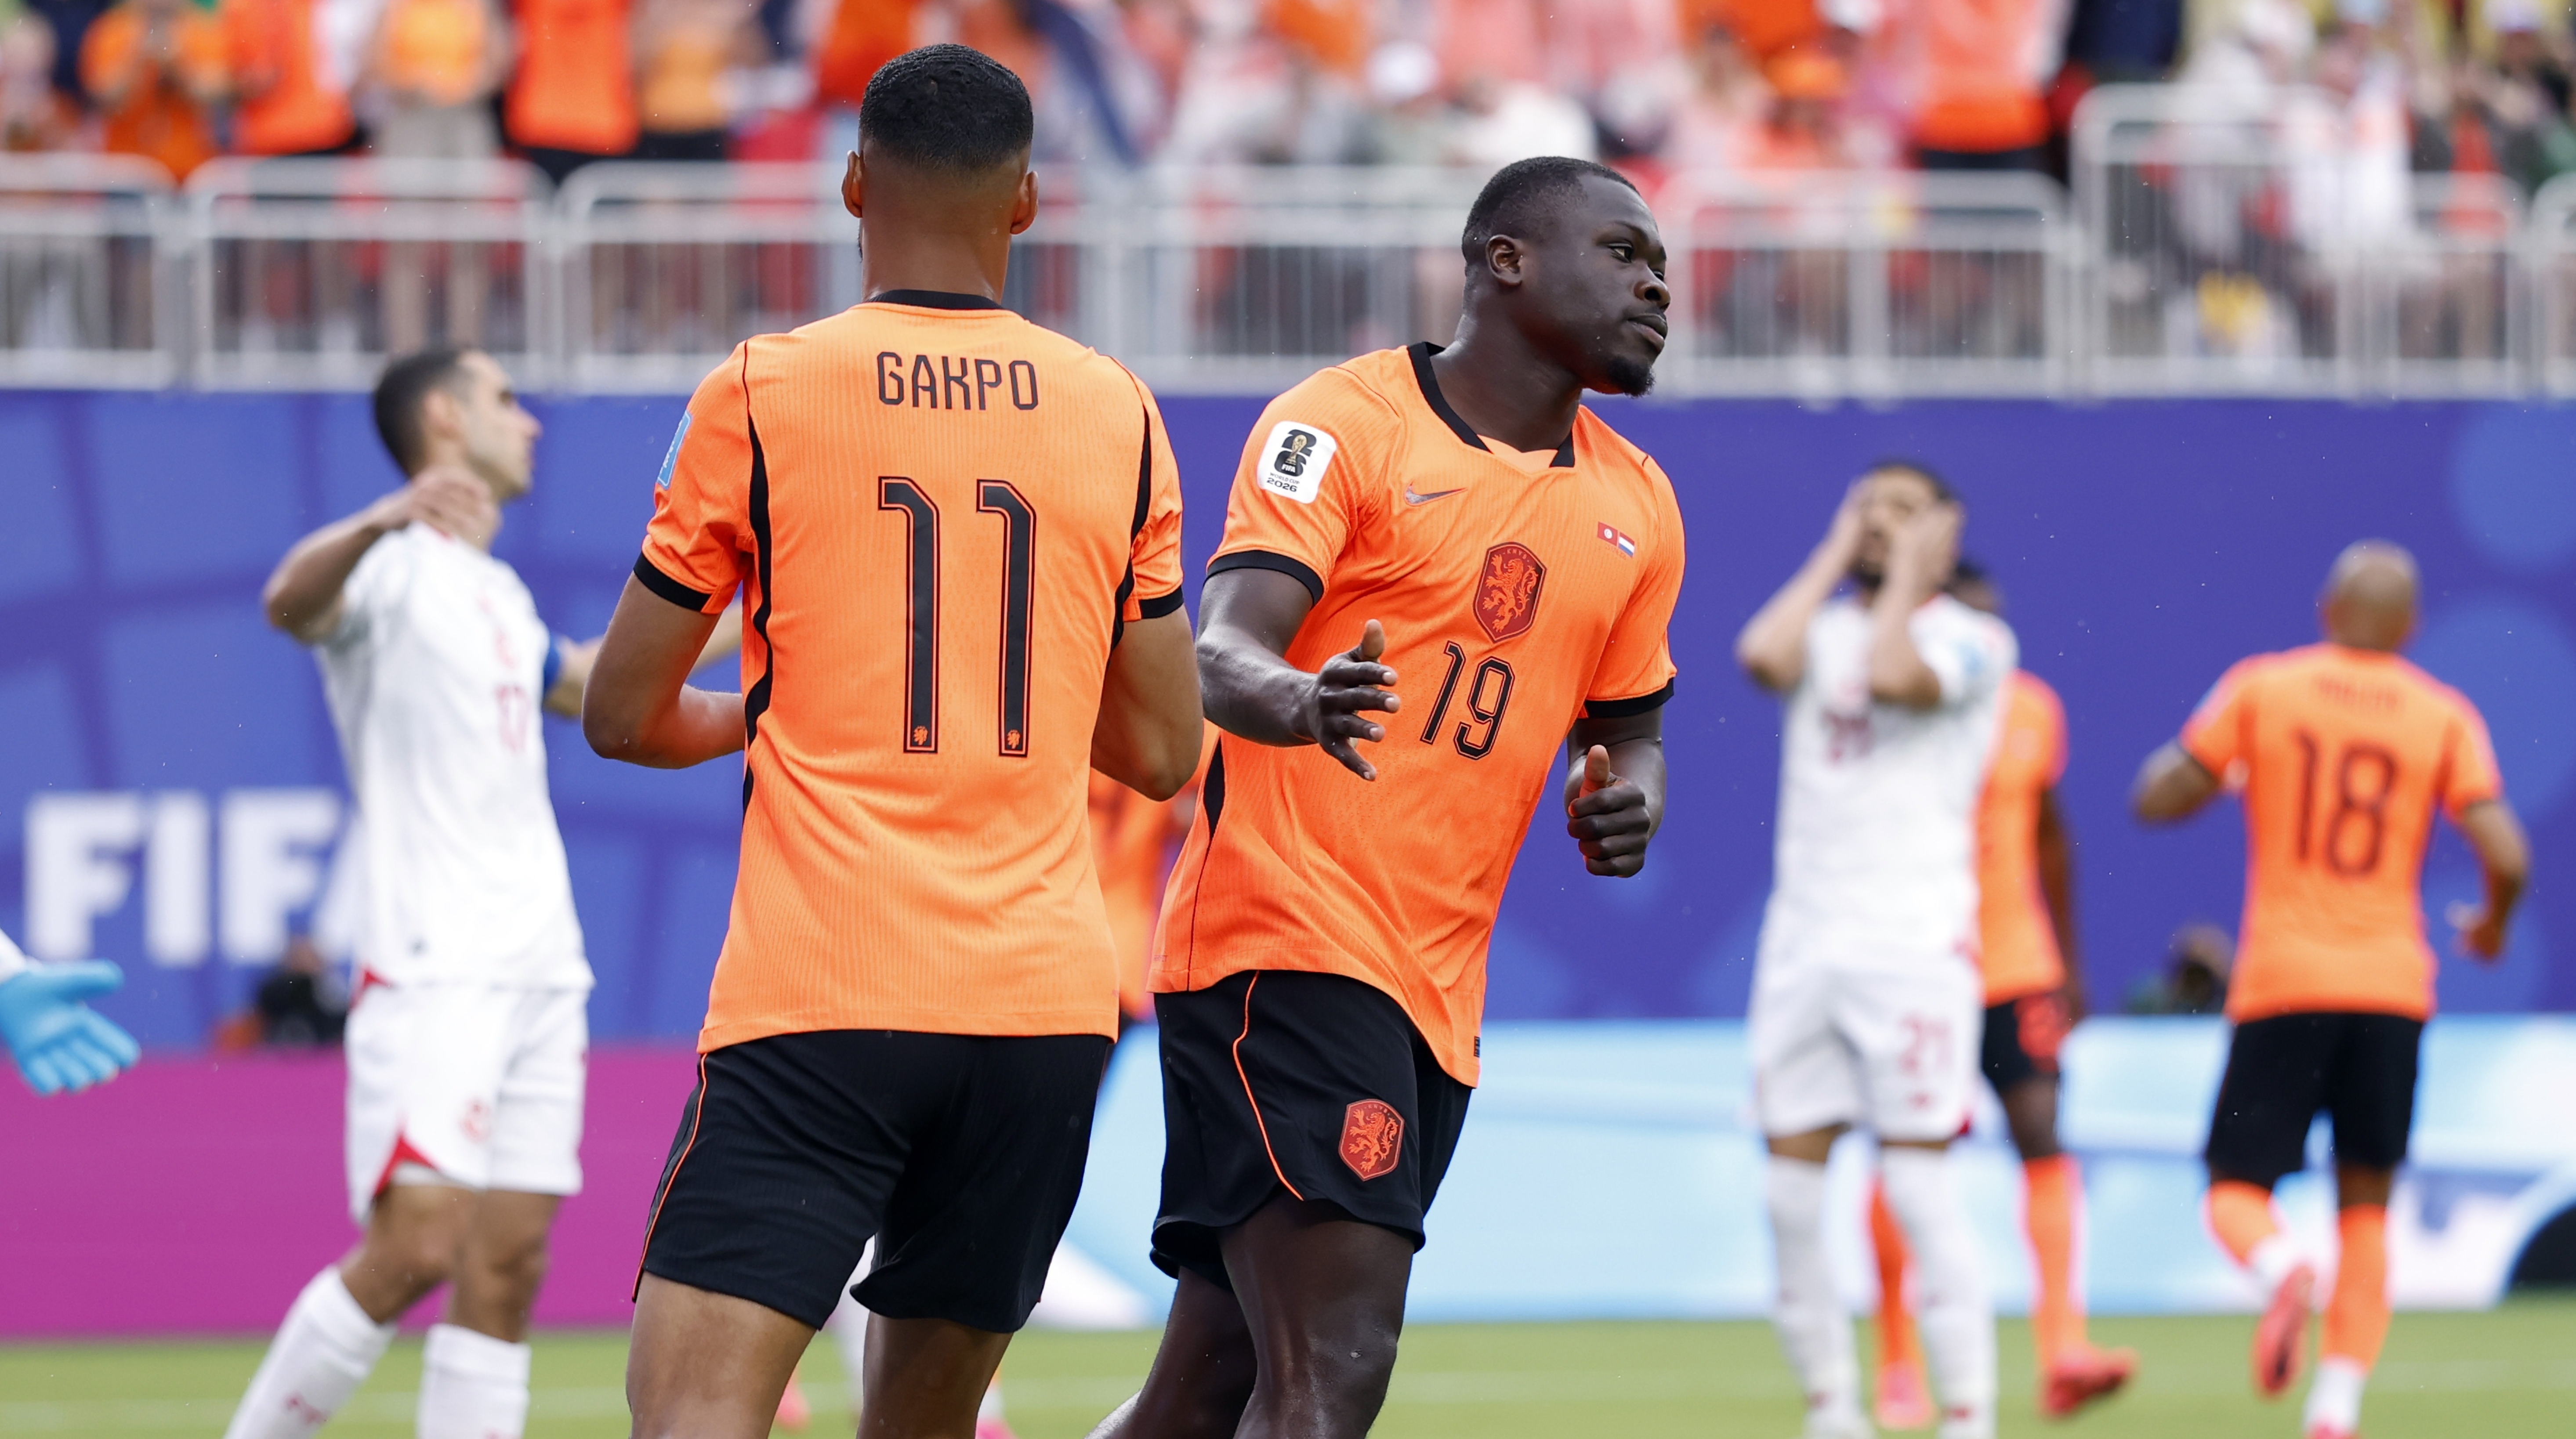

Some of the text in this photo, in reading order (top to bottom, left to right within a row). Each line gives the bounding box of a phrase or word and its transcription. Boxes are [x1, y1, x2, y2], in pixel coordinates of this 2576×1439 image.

[877, 351, 1039, 410] GAKPO
[1266, 477, 1298, 492] 2026
[1270, 472, 1288, 481] WORLD
[1281, 463, 1296, 473] FIFA
[878, 476, 1036, 757] 11
[1420, 640, 1515, 760] 19
[2290, 725, 2399, 880] 18
